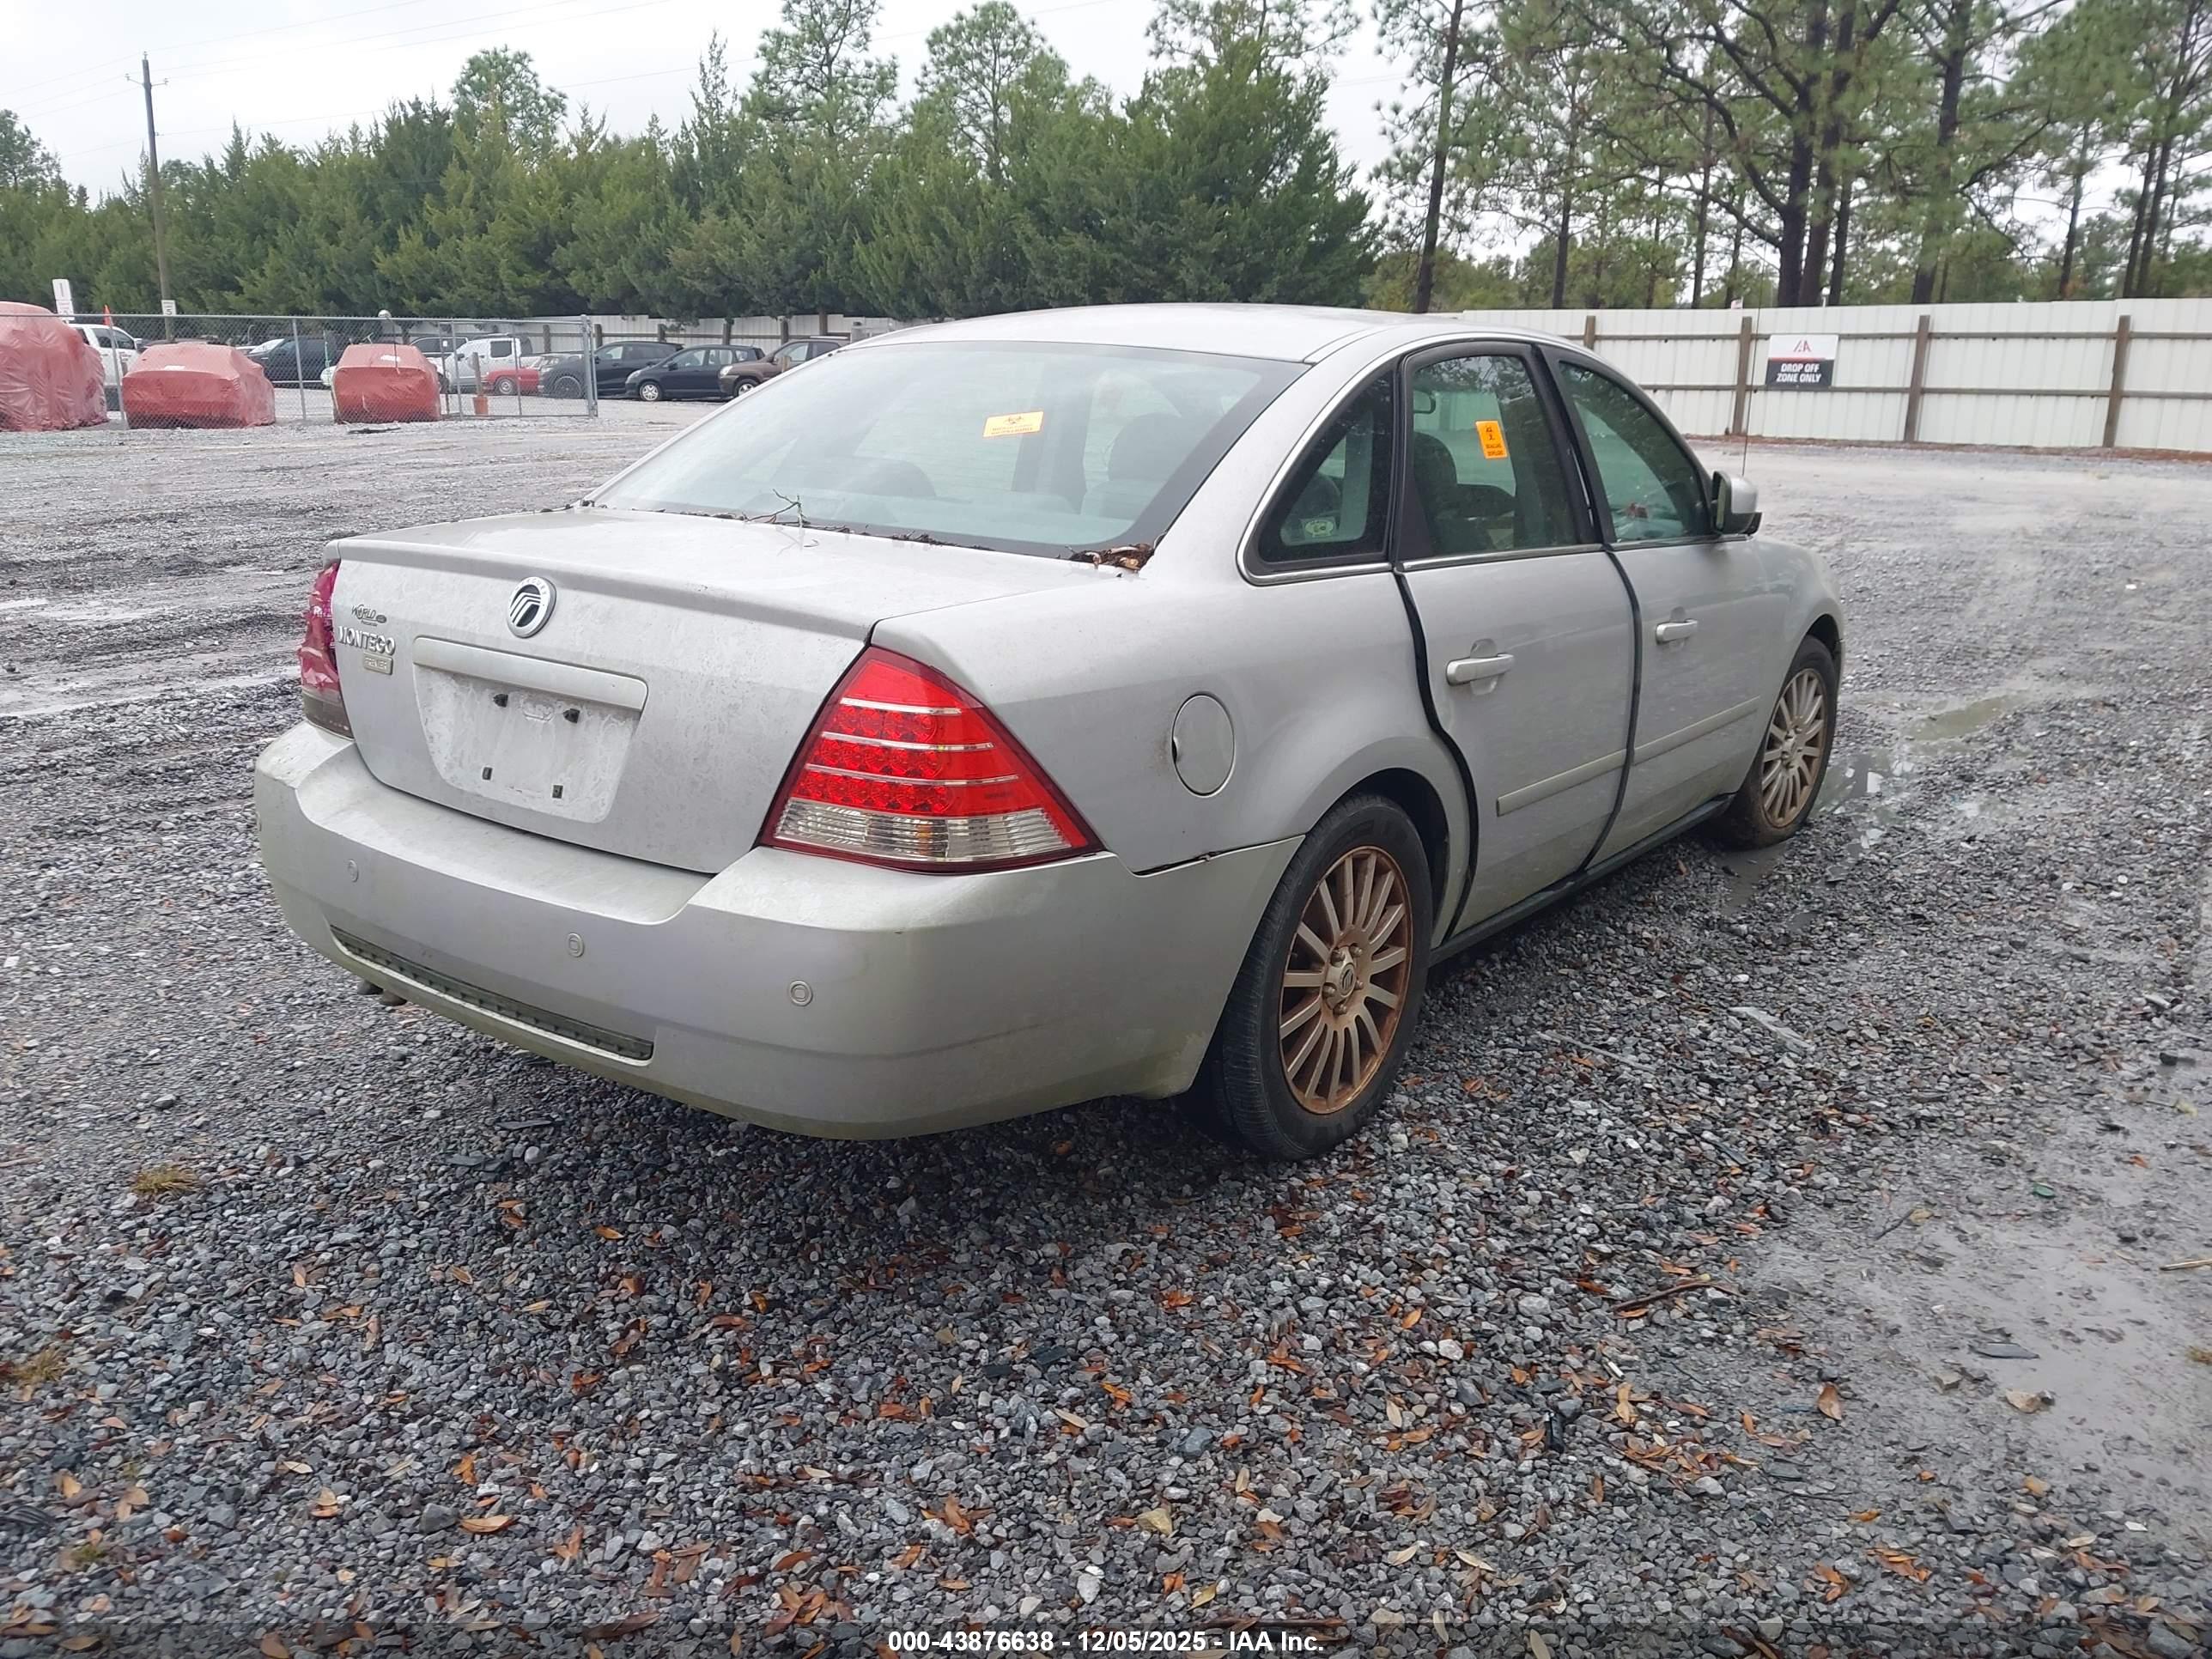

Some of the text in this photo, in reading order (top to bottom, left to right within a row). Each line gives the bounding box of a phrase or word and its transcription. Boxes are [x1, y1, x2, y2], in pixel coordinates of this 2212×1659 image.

[1781, 363, 1820, 373] DROP OFF
[1777, 373, 1821, 383] ZONE ONLY
[337, 625, 396, 656] MONTEGO
